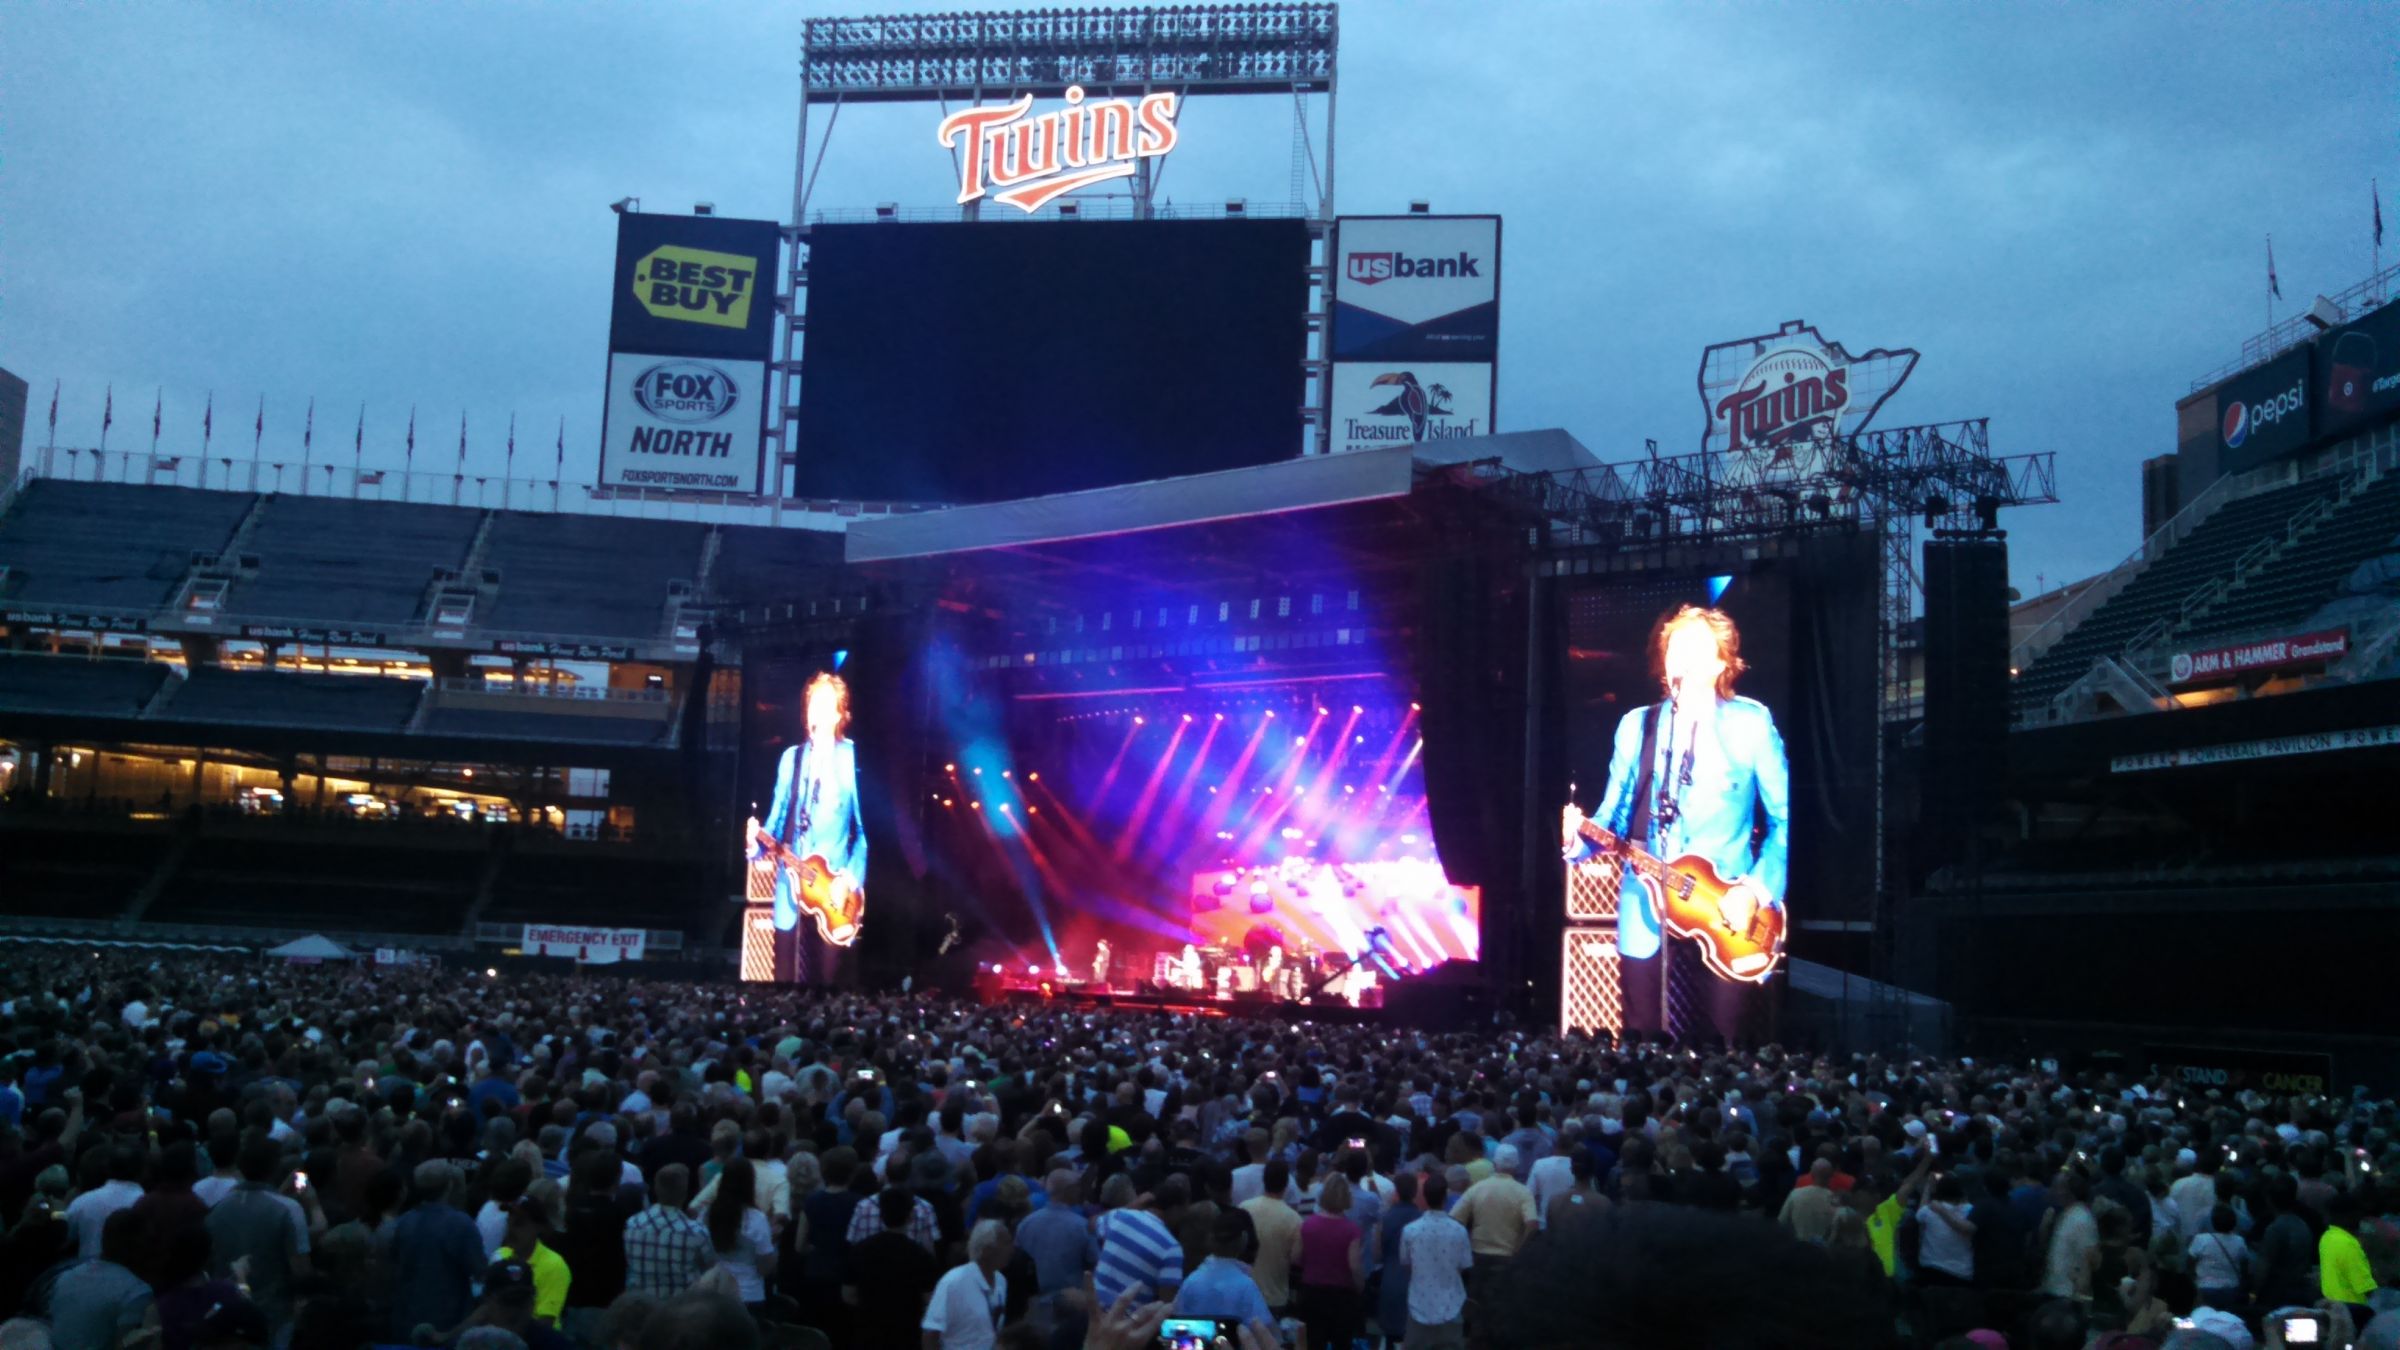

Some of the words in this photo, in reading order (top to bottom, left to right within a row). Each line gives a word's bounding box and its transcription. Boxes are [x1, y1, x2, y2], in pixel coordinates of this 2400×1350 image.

[938, 85, 1177, 204] Twins
[650, 257, 752, 292] BEST
[650, 283, 742, 315] BUY
[656, 373, 715, 400] FOX
[653, 399, 716, 412] SPORTS
[1716, 368, 1849, 453] Twins
[2251, 378, 2304, 435] pepsi
[630, 426, 732, 458] NORTH
[1345, 417, 1411, 441] Treasure
[1428, 418, 1474, 440] Island
[622, 469, 738, 488] FOXSPORTSNORTH.COM
[2194, 655, 2219, 673] ARM
[2222, 652, 2232, 669] &
[2234, 642, 2287, 666] HAMMER
[2291, 635, 2345, 659] Grandstand
[2266, 734, 2332, 756] PAVILION
[528, 928, 608, 946] EMERGENCY
[611, 932, 640, 946] EXIT
